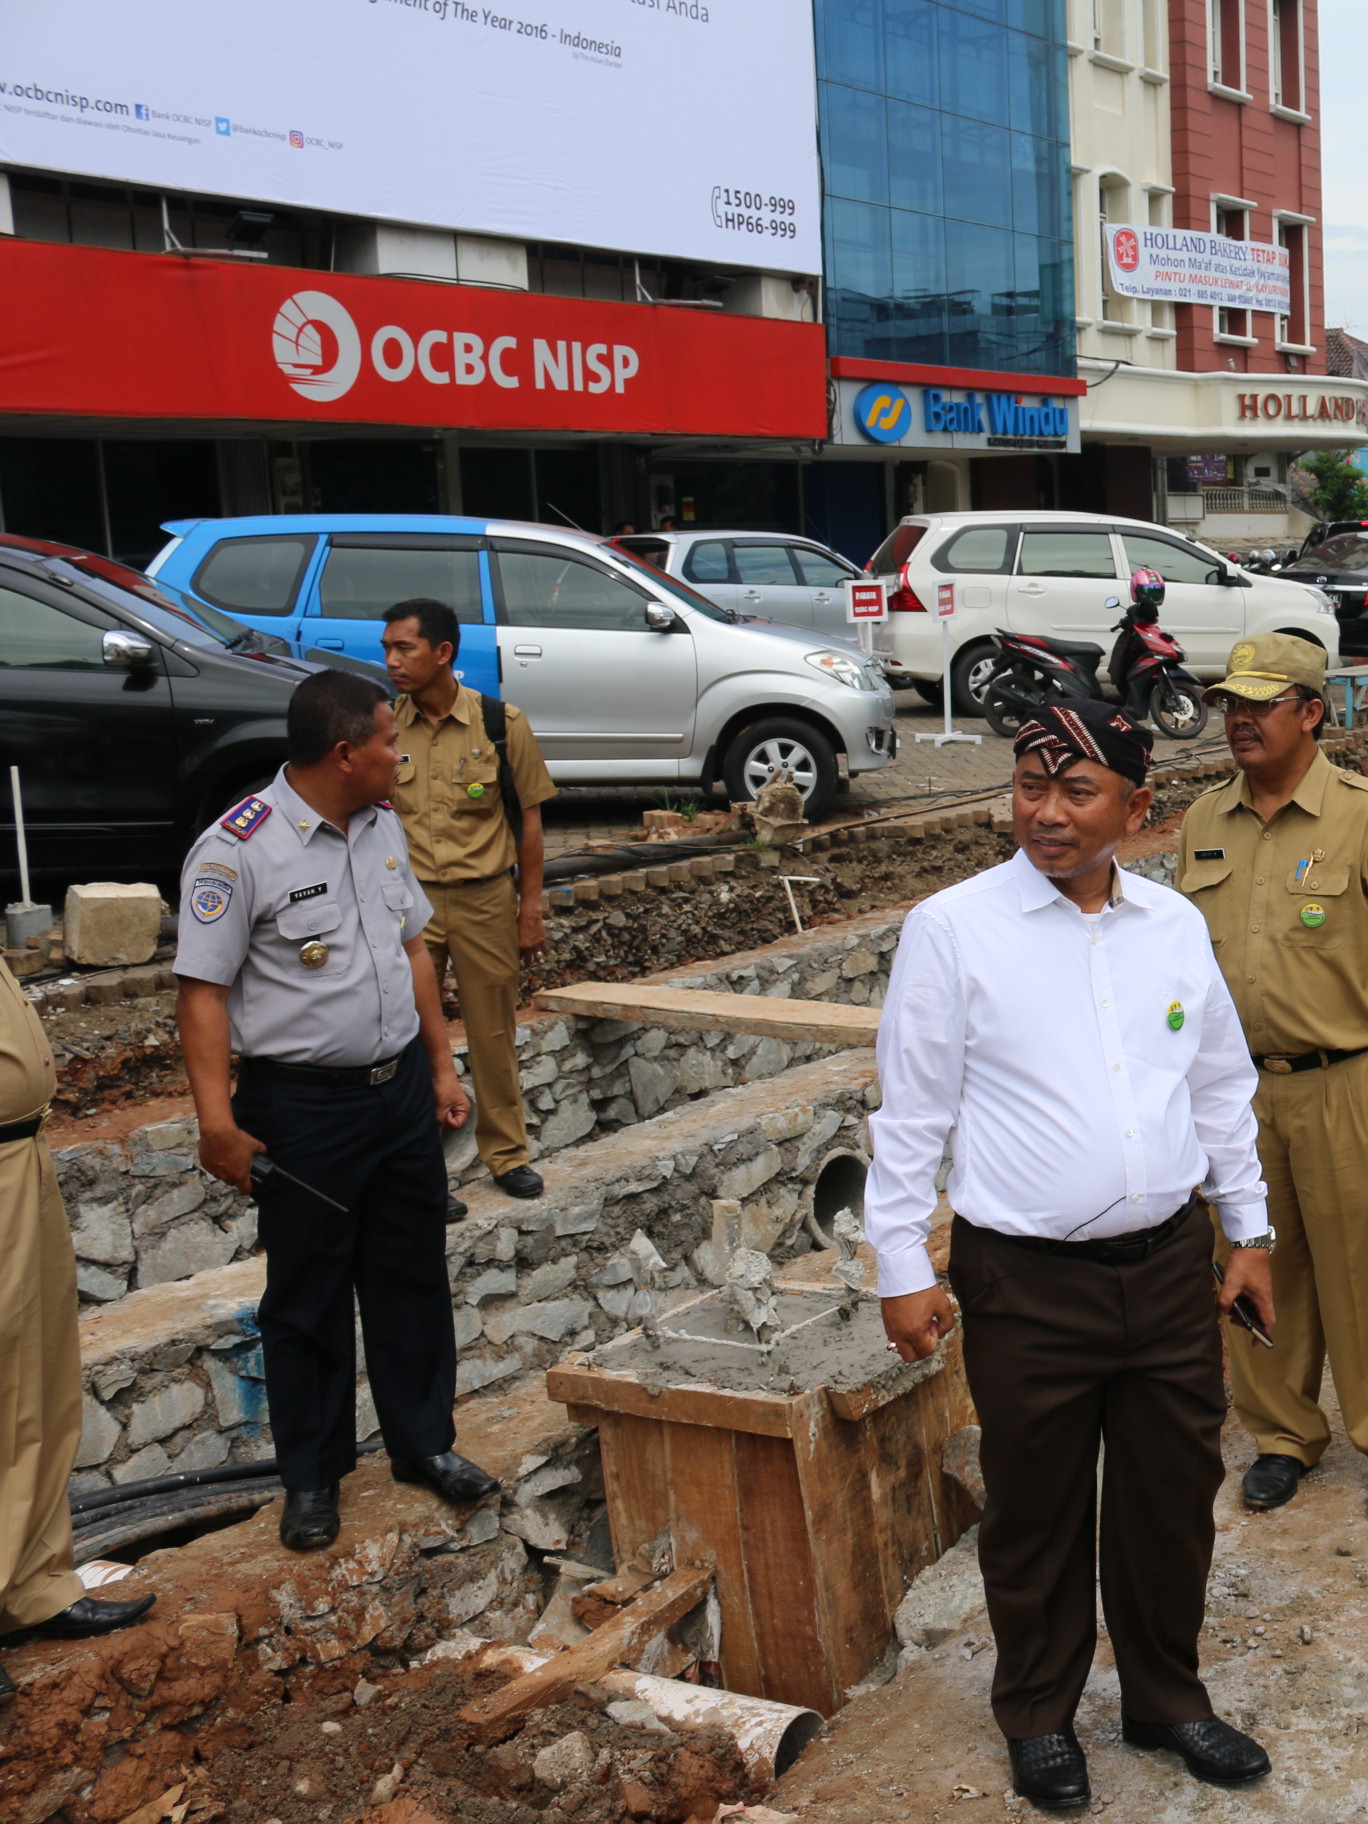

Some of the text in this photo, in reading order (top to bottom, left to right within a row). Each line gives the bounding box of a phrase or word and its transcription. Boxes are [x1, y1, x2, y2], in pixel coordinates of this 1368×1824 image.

[665, 0, 709, 23] Anda
[433, 0, 449, 20] of
[452, 1, 478, 23] The
[481, 8, 513, 32] Year
[516, 21, 549, 41] 2016
[559, 28, 622, 58] Indonesia
[151, 109, 171, 120] Bank
[172, 113, 194, 125] OCBC
[194, 117, 212, 127] NISP
[723, 188, 795, 216] 1500-999
[724, 211, 797, 239] HP66-999
[1143, 231, 1207, 254] HOLLAND
[1209, 240, 1249, 262] BAKERY
[1250, 247, 1277, 264] TETAP
[1149, 253, 1186, 268] Mohon
[1188, 256, 1212, 272] Ma'af
[1213, 261, 1229, 273] atas
[1229, 263, 1256, 279] Ketidak
[1154, 270, 1186, 284] PINTU
[1188, 273, 1220, 287] MASUK
[1220, 276, 1245, 290] LEWAT
[1119, 283, 1139, 294] Telp.
[1141, 285, 1173, 297] Layanan
[1178, 288, 1192, 298] 021
[371, 324, 639, 395] OCBC NISP
[922, 388, 1069, 436] Bank Windu
[1237, 393, 1356, 421] HOLLAND
